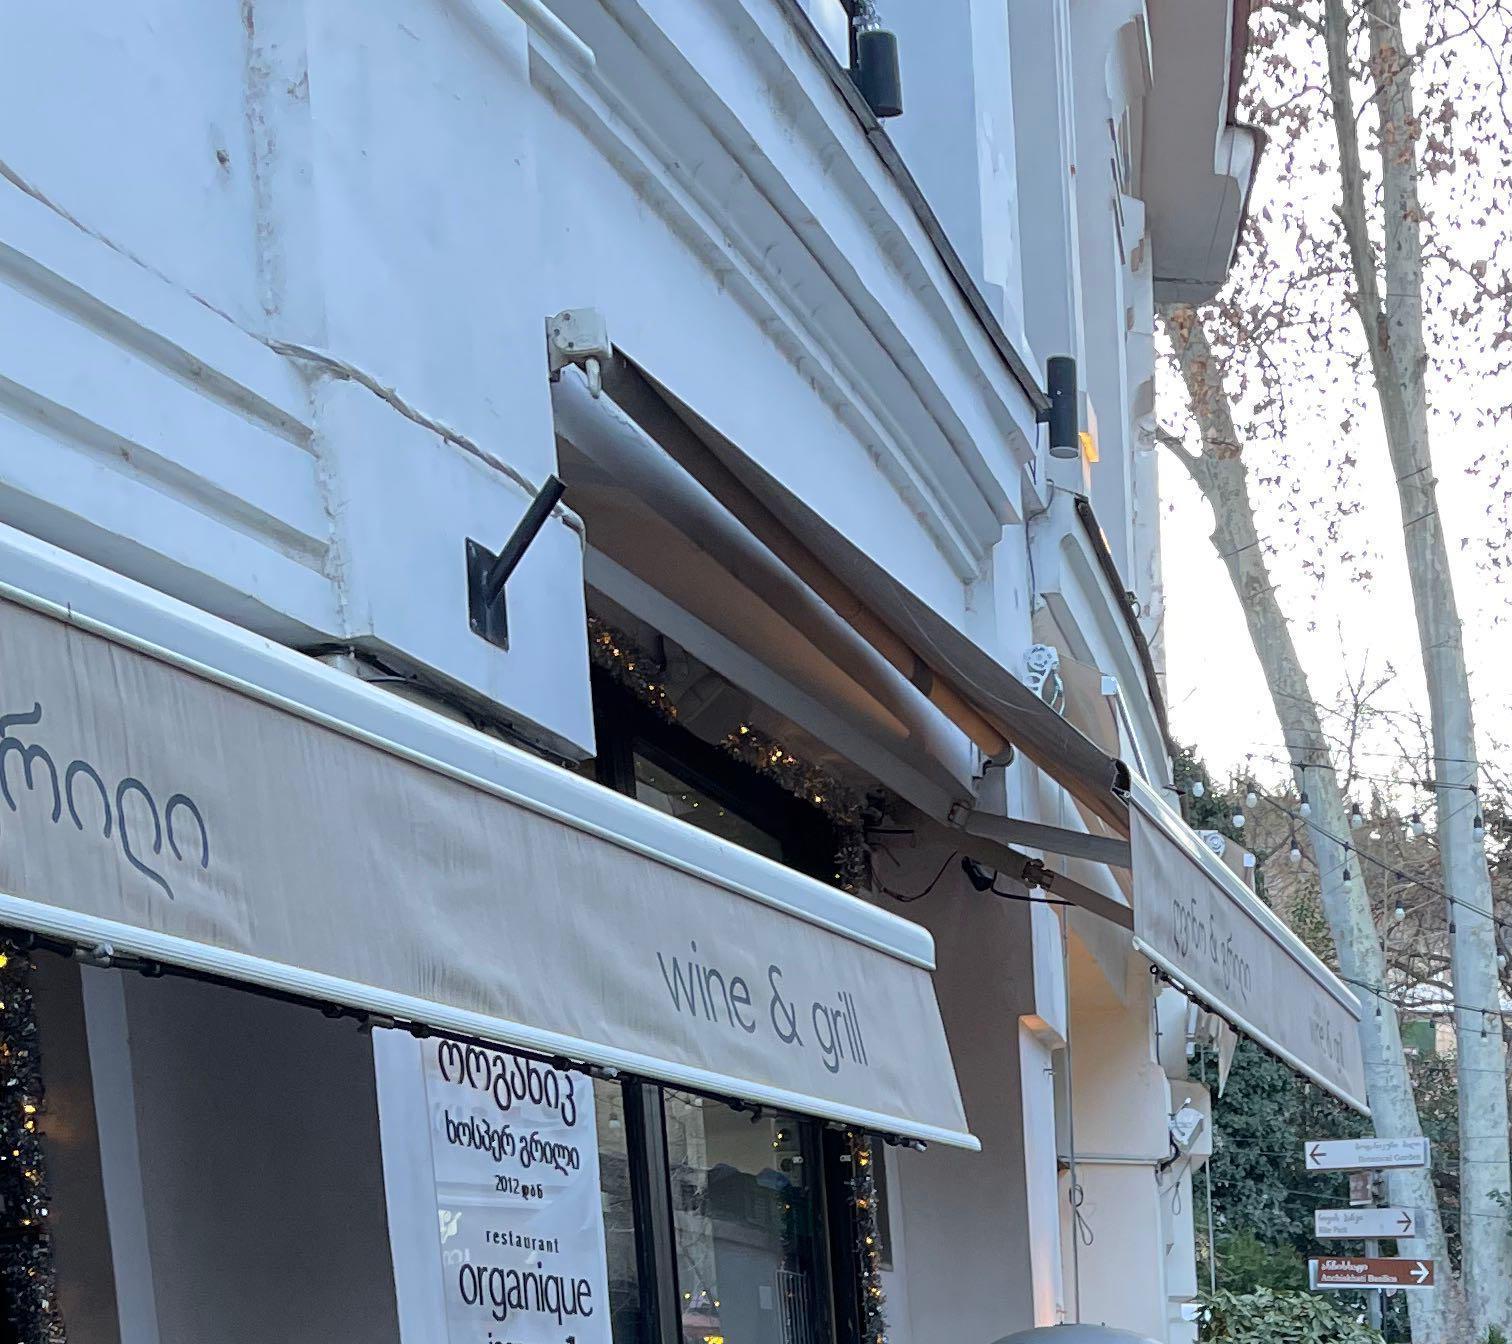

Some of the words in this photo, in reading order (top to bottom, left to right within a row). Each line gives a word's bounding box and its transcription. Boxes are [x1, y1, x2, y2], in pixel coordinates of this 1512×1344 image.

[656, 940, 756, 1034] wine
[768, 964, 804, 1047] &
[812, 991, 868, 1074] grill
[494, 1174, 520, 1195] 2012
[486, 1229, 560, 1254] restaurant
[459, 1261, 593, 1326] organique
